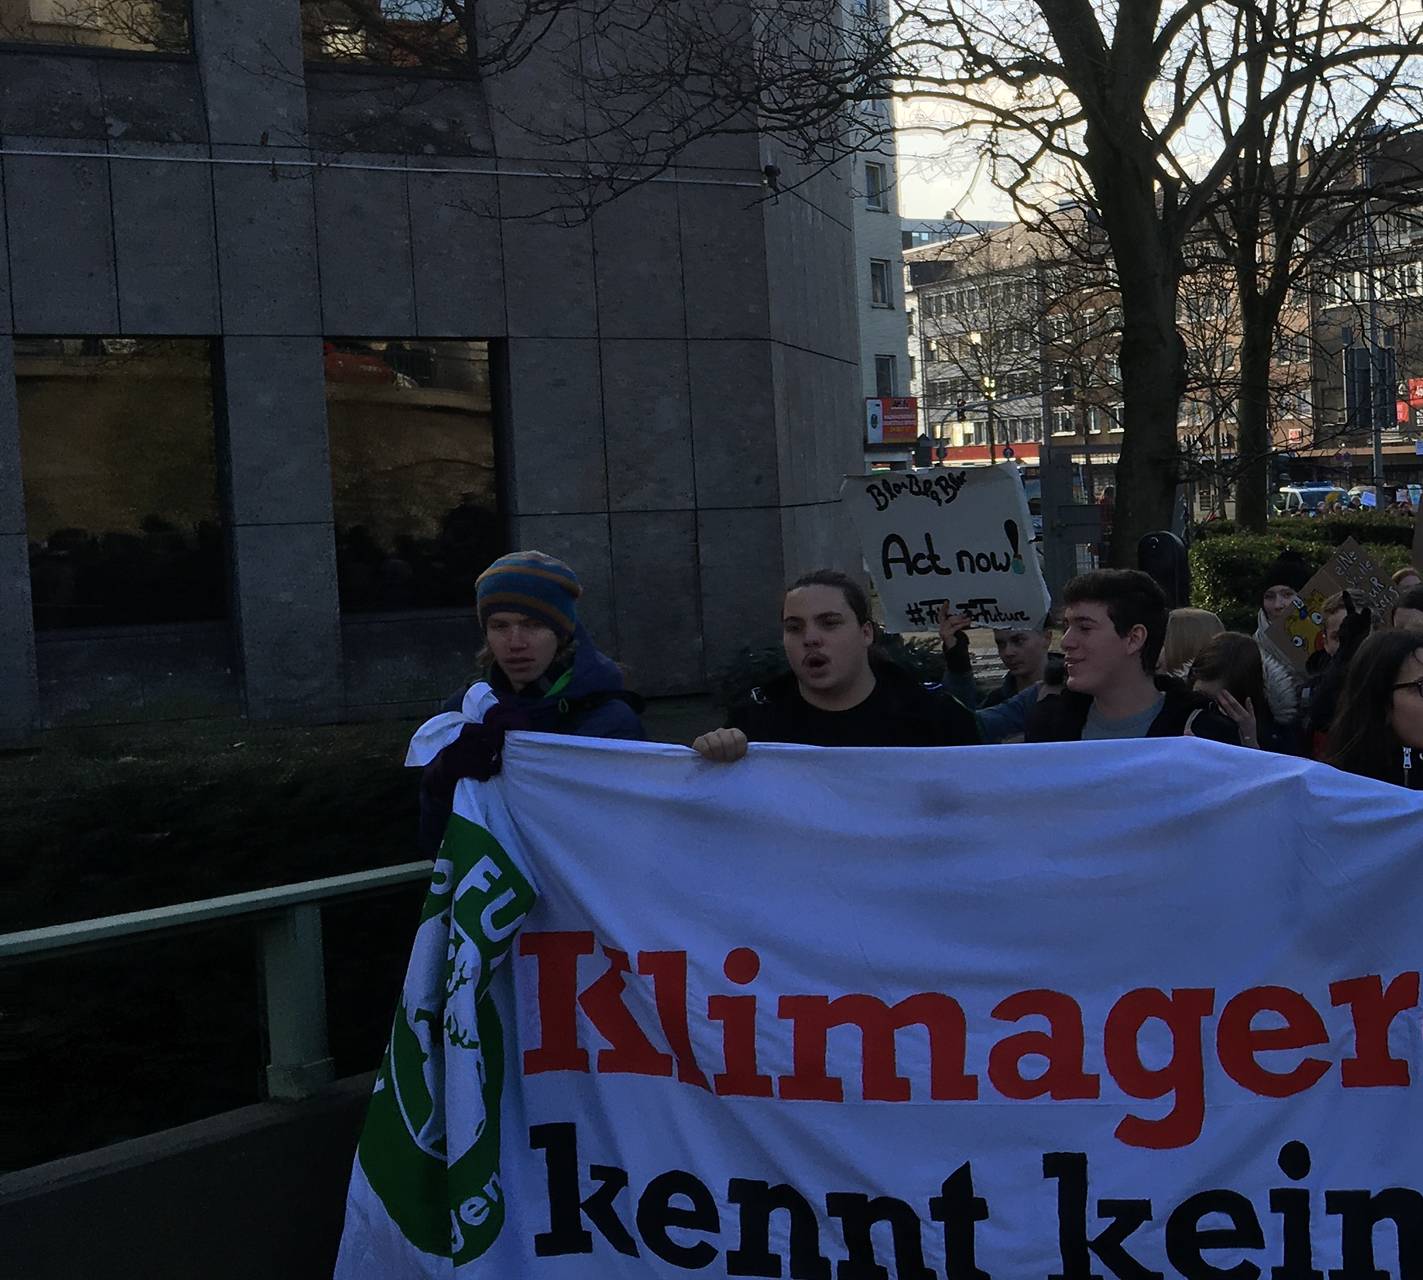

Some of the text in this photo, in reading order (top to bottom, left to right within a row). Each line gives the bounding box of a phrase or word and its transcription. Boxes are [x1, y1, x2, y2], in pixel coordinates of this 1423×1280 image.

[881, 519, 1026, 579] Act now!
[453, 853, 527, 944] FU
[530, 1121, 990, 1280] kennt
